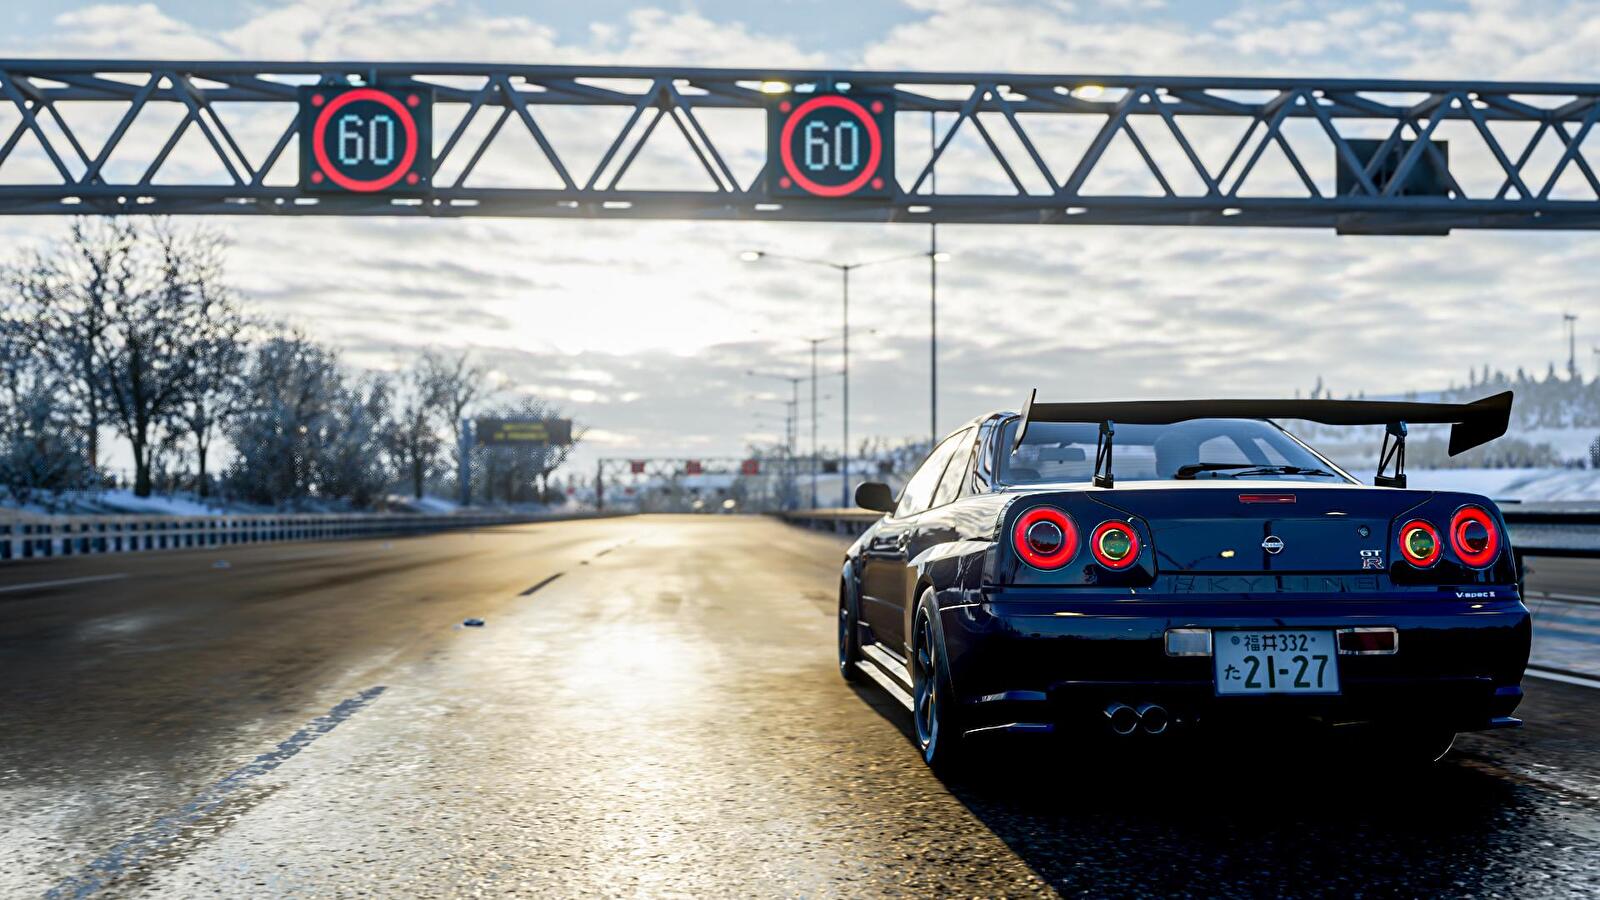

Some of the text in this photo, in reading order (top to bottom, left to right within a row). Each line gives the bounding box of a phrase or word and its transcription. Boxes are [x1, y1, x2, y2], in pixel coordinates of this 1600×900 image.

[338, 114, 394, 165] 60
[804, 121, 859, 171] 60
[1361, 556, 1384, 569] R
[1224, 655, 1329, 688] た 21-27
